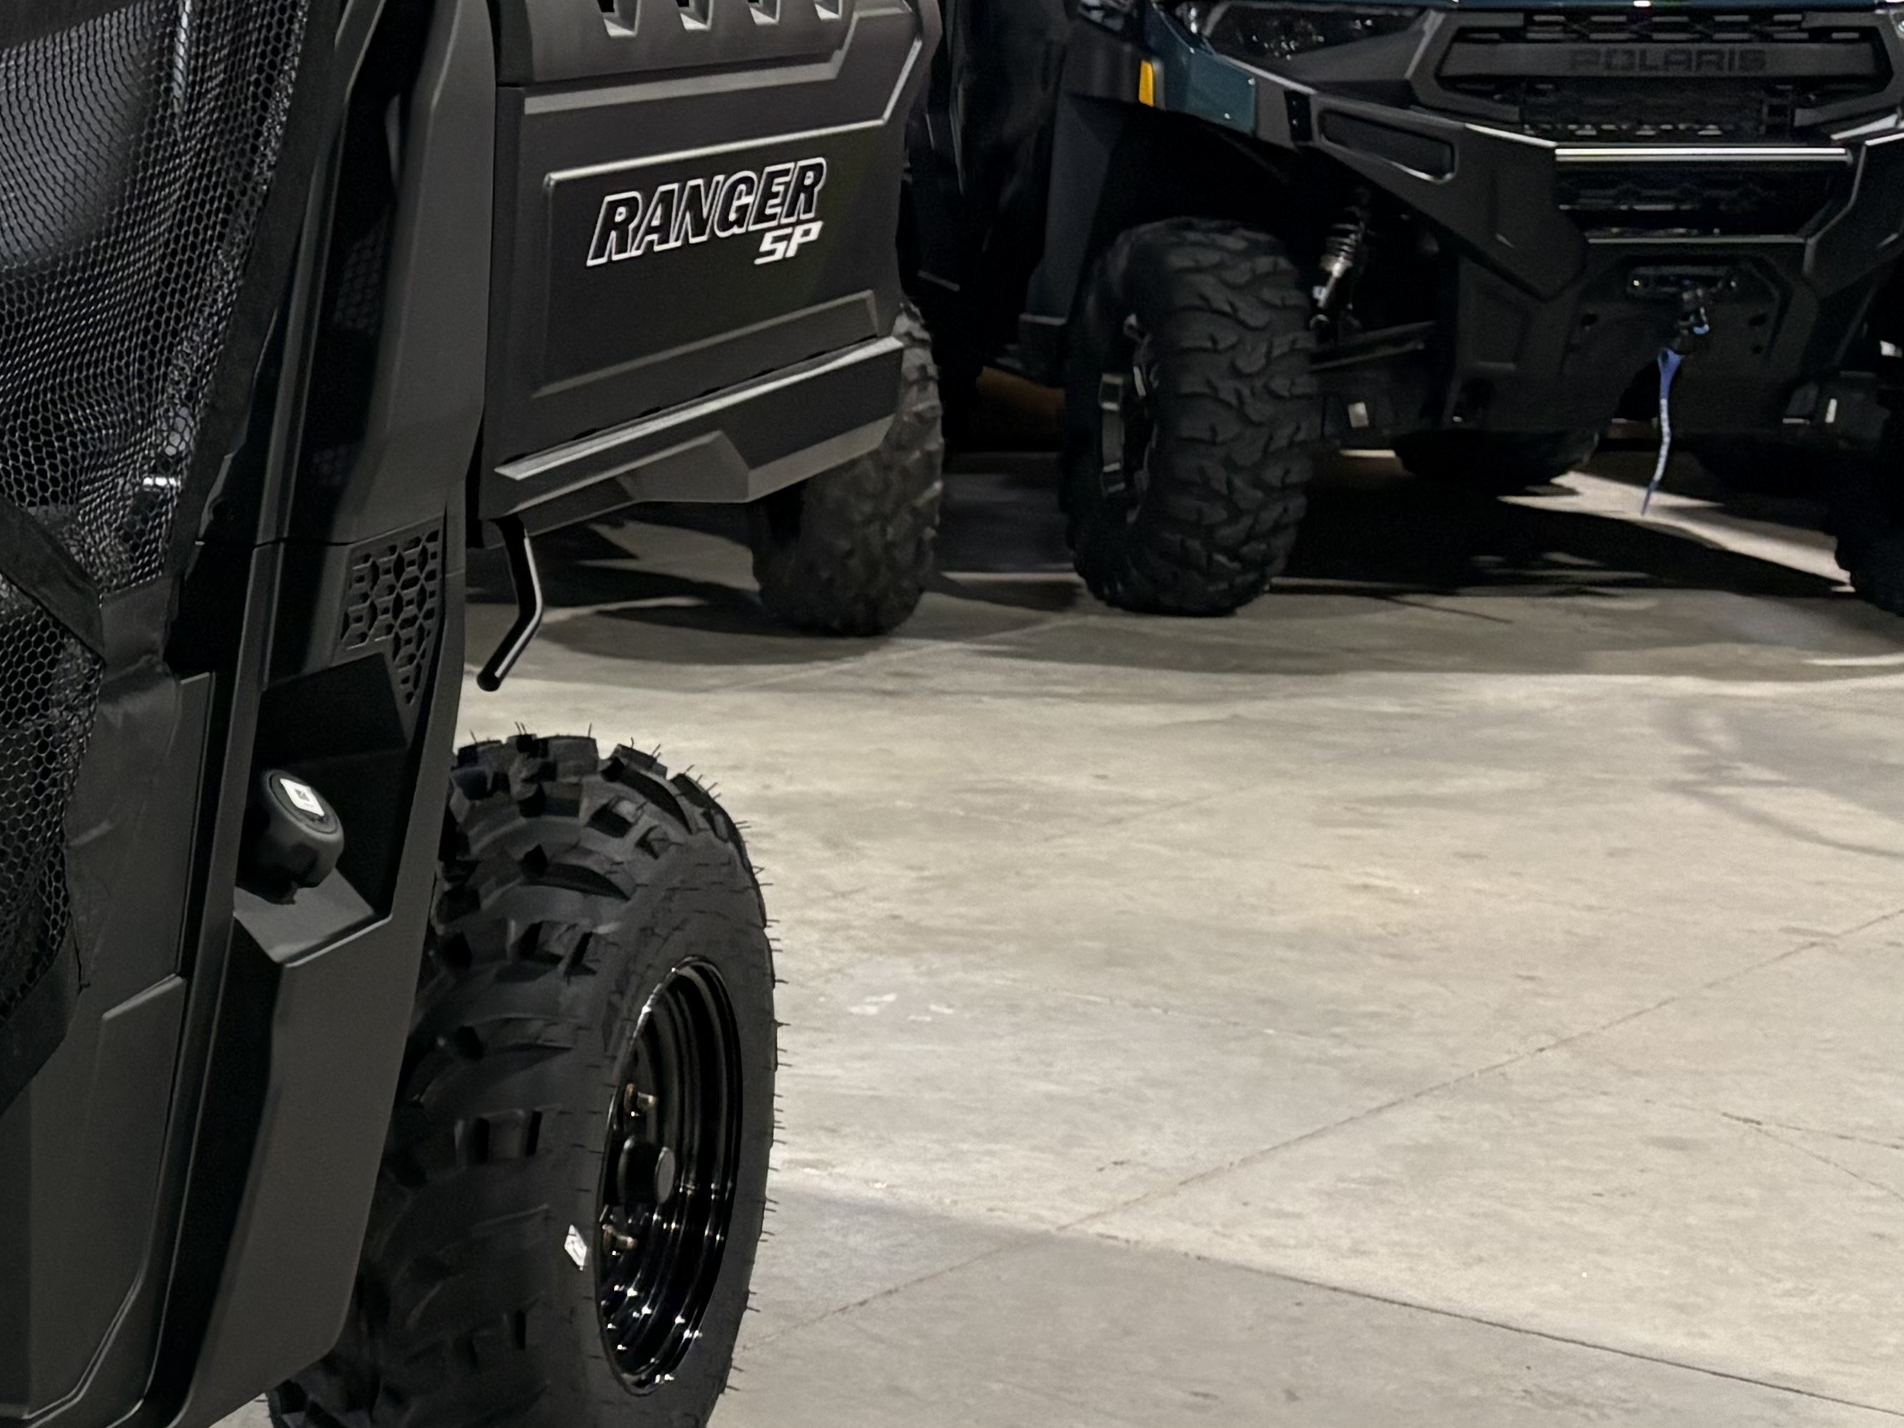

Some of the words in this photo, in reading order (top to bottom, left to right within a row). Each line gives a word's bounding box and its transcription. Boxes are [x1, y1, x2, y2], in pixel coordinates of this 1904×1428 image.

[1569, 47, 1769, 73] POLARIS
[586, 157, 828, 267] RANGER
[754, 220, 824, 266] SP
